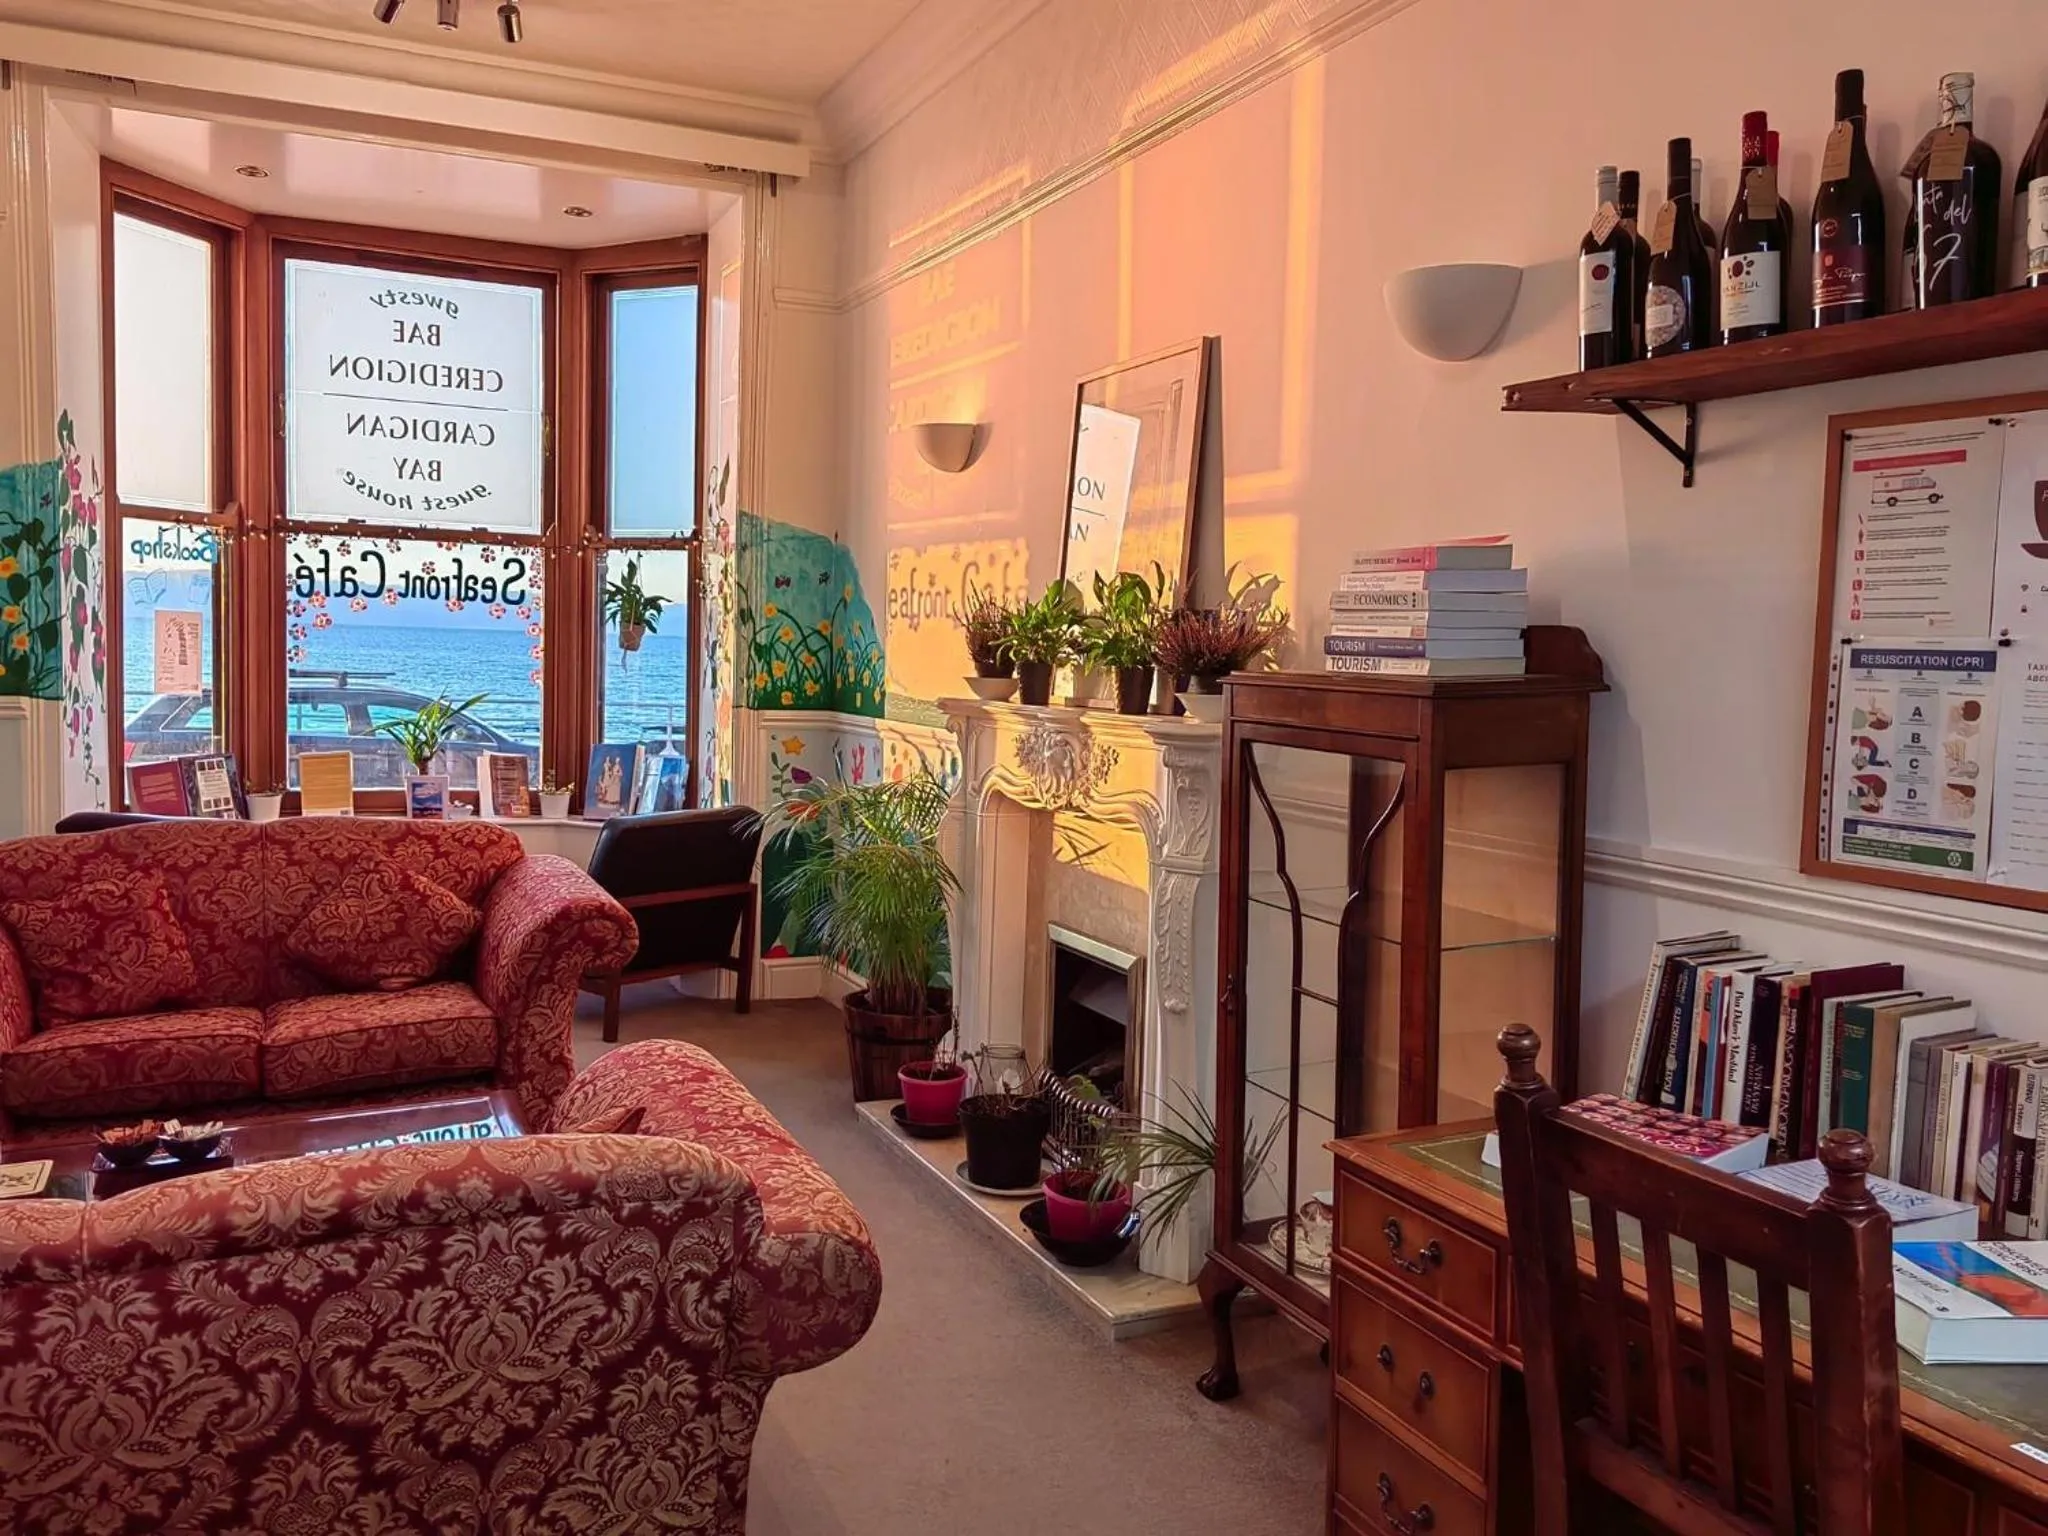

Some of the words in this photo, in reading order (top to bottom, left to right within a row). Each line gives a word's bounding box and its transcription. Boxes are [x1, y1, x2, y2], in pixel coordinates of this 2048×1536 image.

[1353, 592, 1408, 606] ECONOMICS
[1329, 640, 1366, 653] TOURISM
[1331, 657, 1382, 672] TOURISM
[1860, 653, 1948, 666] RESUSCITATION
[1951, 656, 1985, 667] (CPR)
[1912, 706, 1923, 717] A
[1911, 733, 1921, 744] B
[1909, 759, 1919, 770] C
[1907, 789, 1917, 799] D
